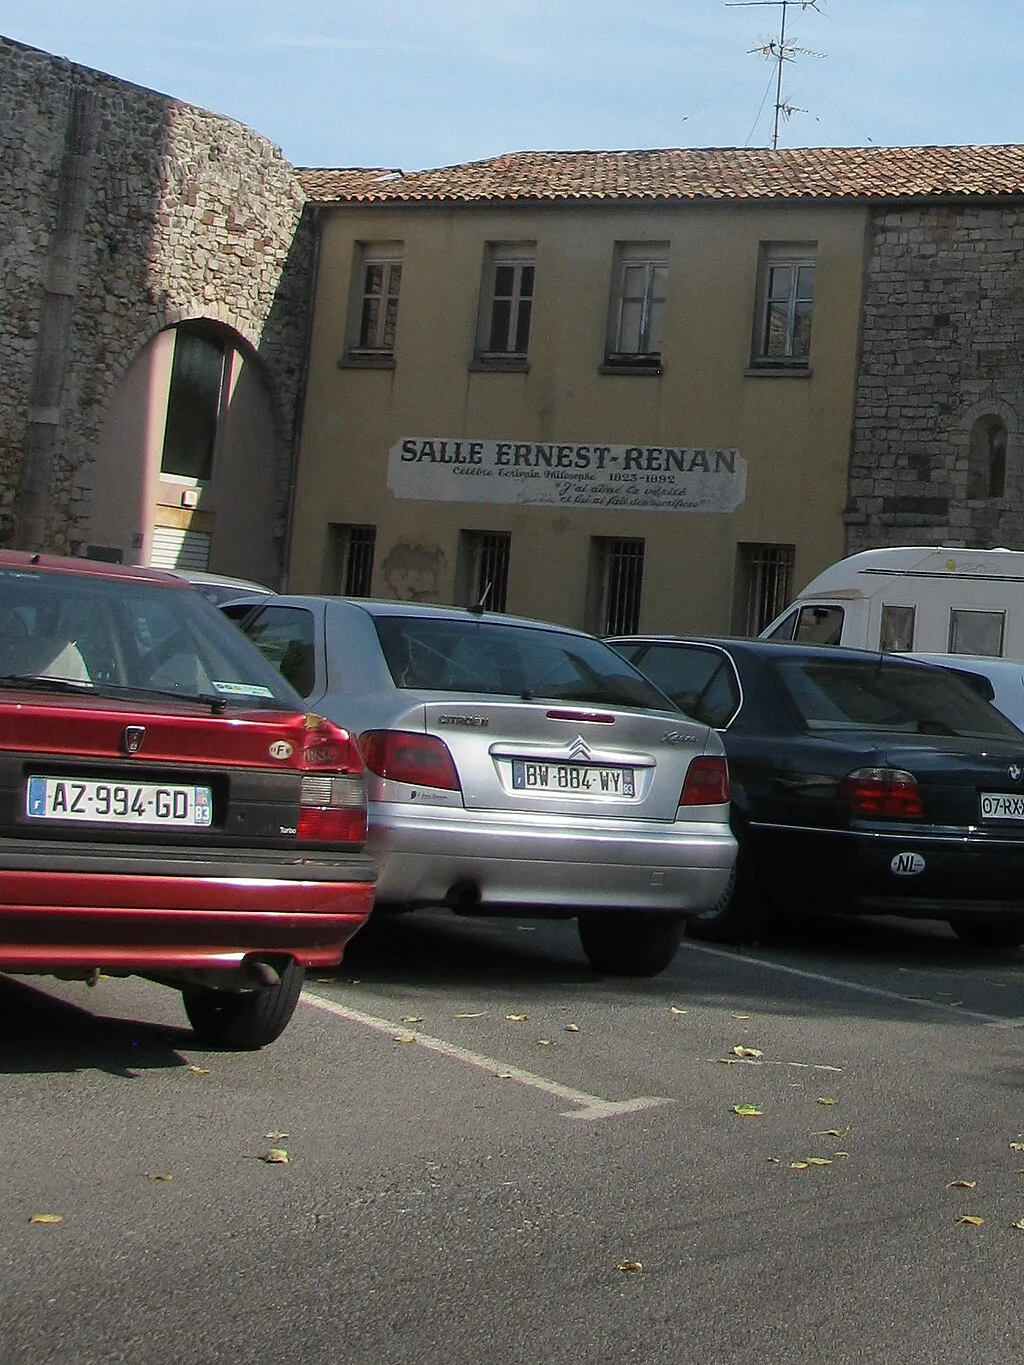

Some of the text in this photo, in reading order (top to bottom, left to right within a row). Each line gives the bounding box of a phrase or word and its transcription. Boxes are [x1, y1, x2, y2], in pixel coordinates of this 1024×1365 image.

[401, 439, 737, 474] SALLE ERNEST-RENAN
[609, 472, 676, 484] 1823-1892
[626, 485, 639, 495] la
[623, 784, 633, 794] 83
[52, 782, 189, 819] AZ-994-GD
[195, 806, 211, 821] 83
[279, 826, 297, 834] Turbo
[896, 855, 916, 873] NL
